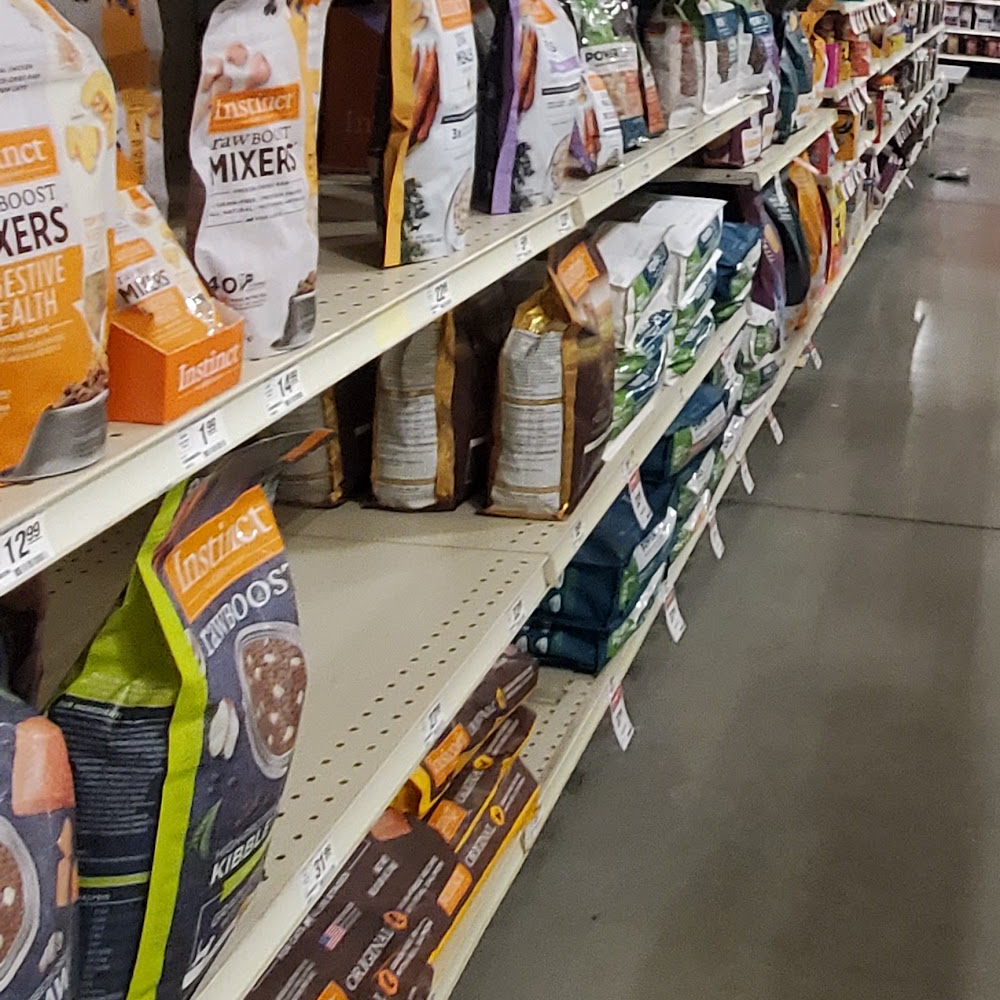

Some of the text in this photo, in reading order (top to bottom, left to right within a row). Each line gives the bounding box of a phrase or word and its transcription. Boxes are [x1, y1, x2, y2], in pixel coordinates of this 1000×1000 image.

[214, 92, 294, 120] Instinct
[209, 143, 297, 186] MIXERS
[0, 255, 66, 299] ESTIVE
[178, 344, 240, 392] Instinct
[173, 504, 273, 593] Instinct
